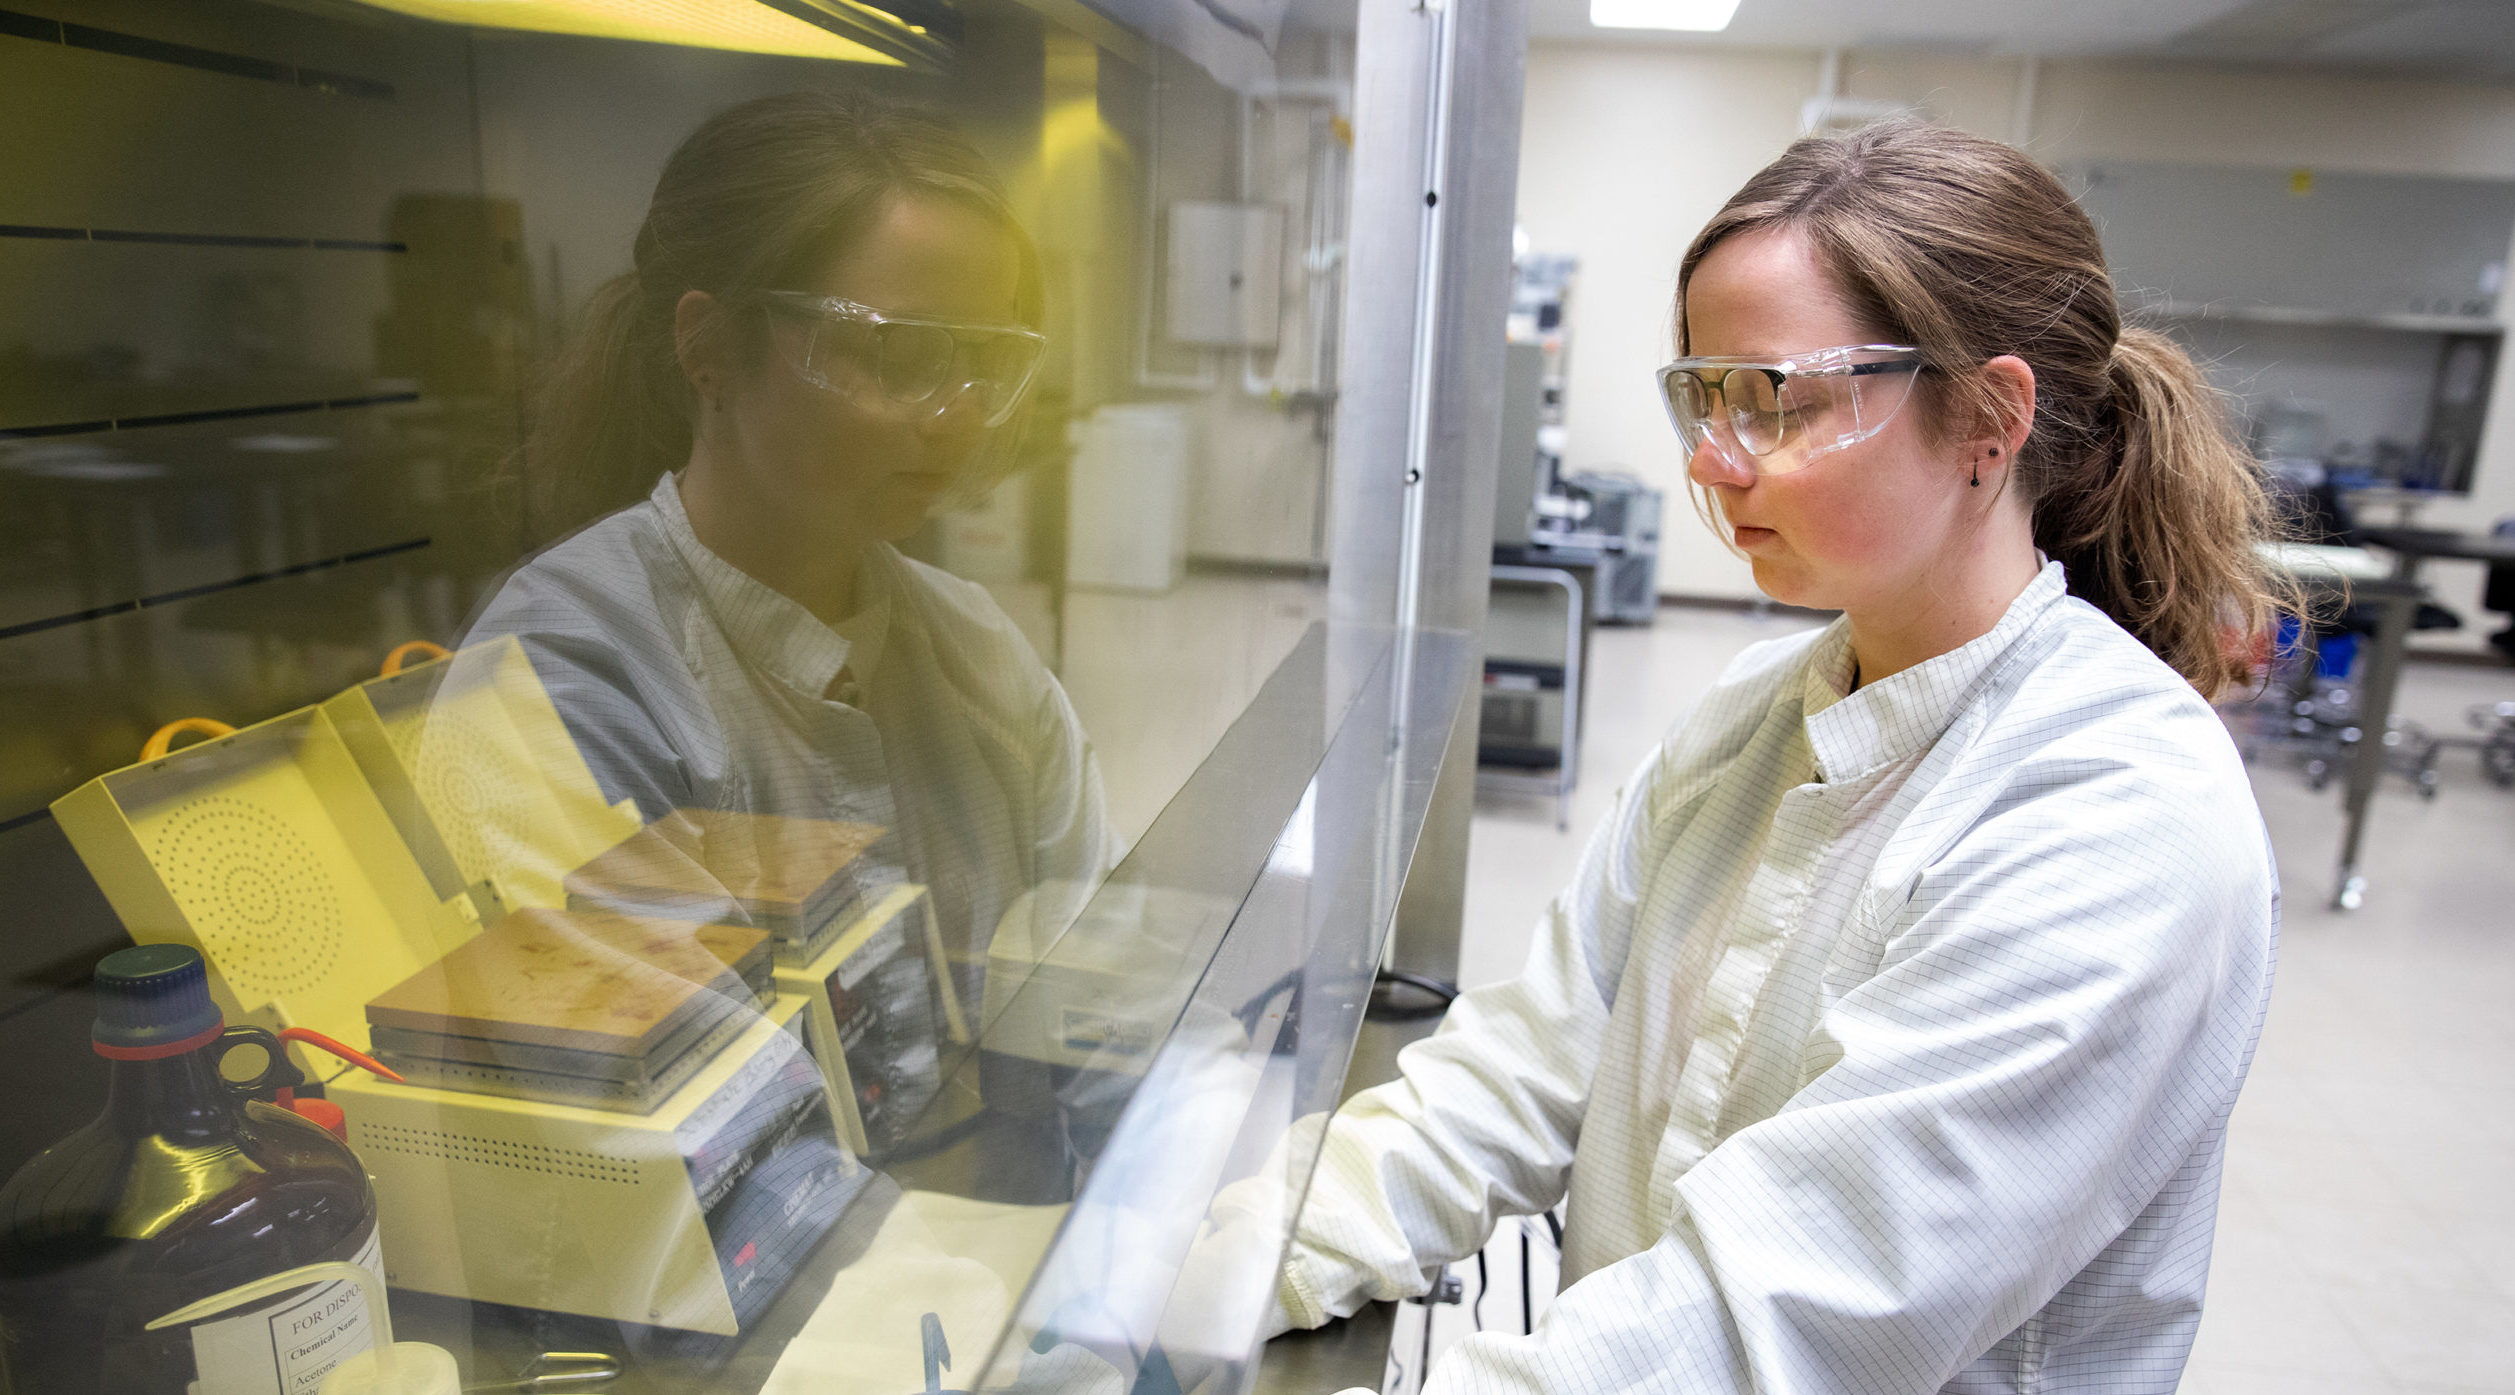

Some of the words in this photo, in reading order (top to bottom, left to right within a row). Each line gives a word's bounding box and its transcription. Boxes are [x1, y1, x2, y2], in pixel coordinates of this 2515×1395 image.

[292, 1311, 324, 1335] FOR
[325, 1283, 361, 1316] DISPO
[290, 1328, 337, 1361] Chemical
[337, 1314, 359, 1335] Name
[294, 1359, 337, 1388] Acetone
